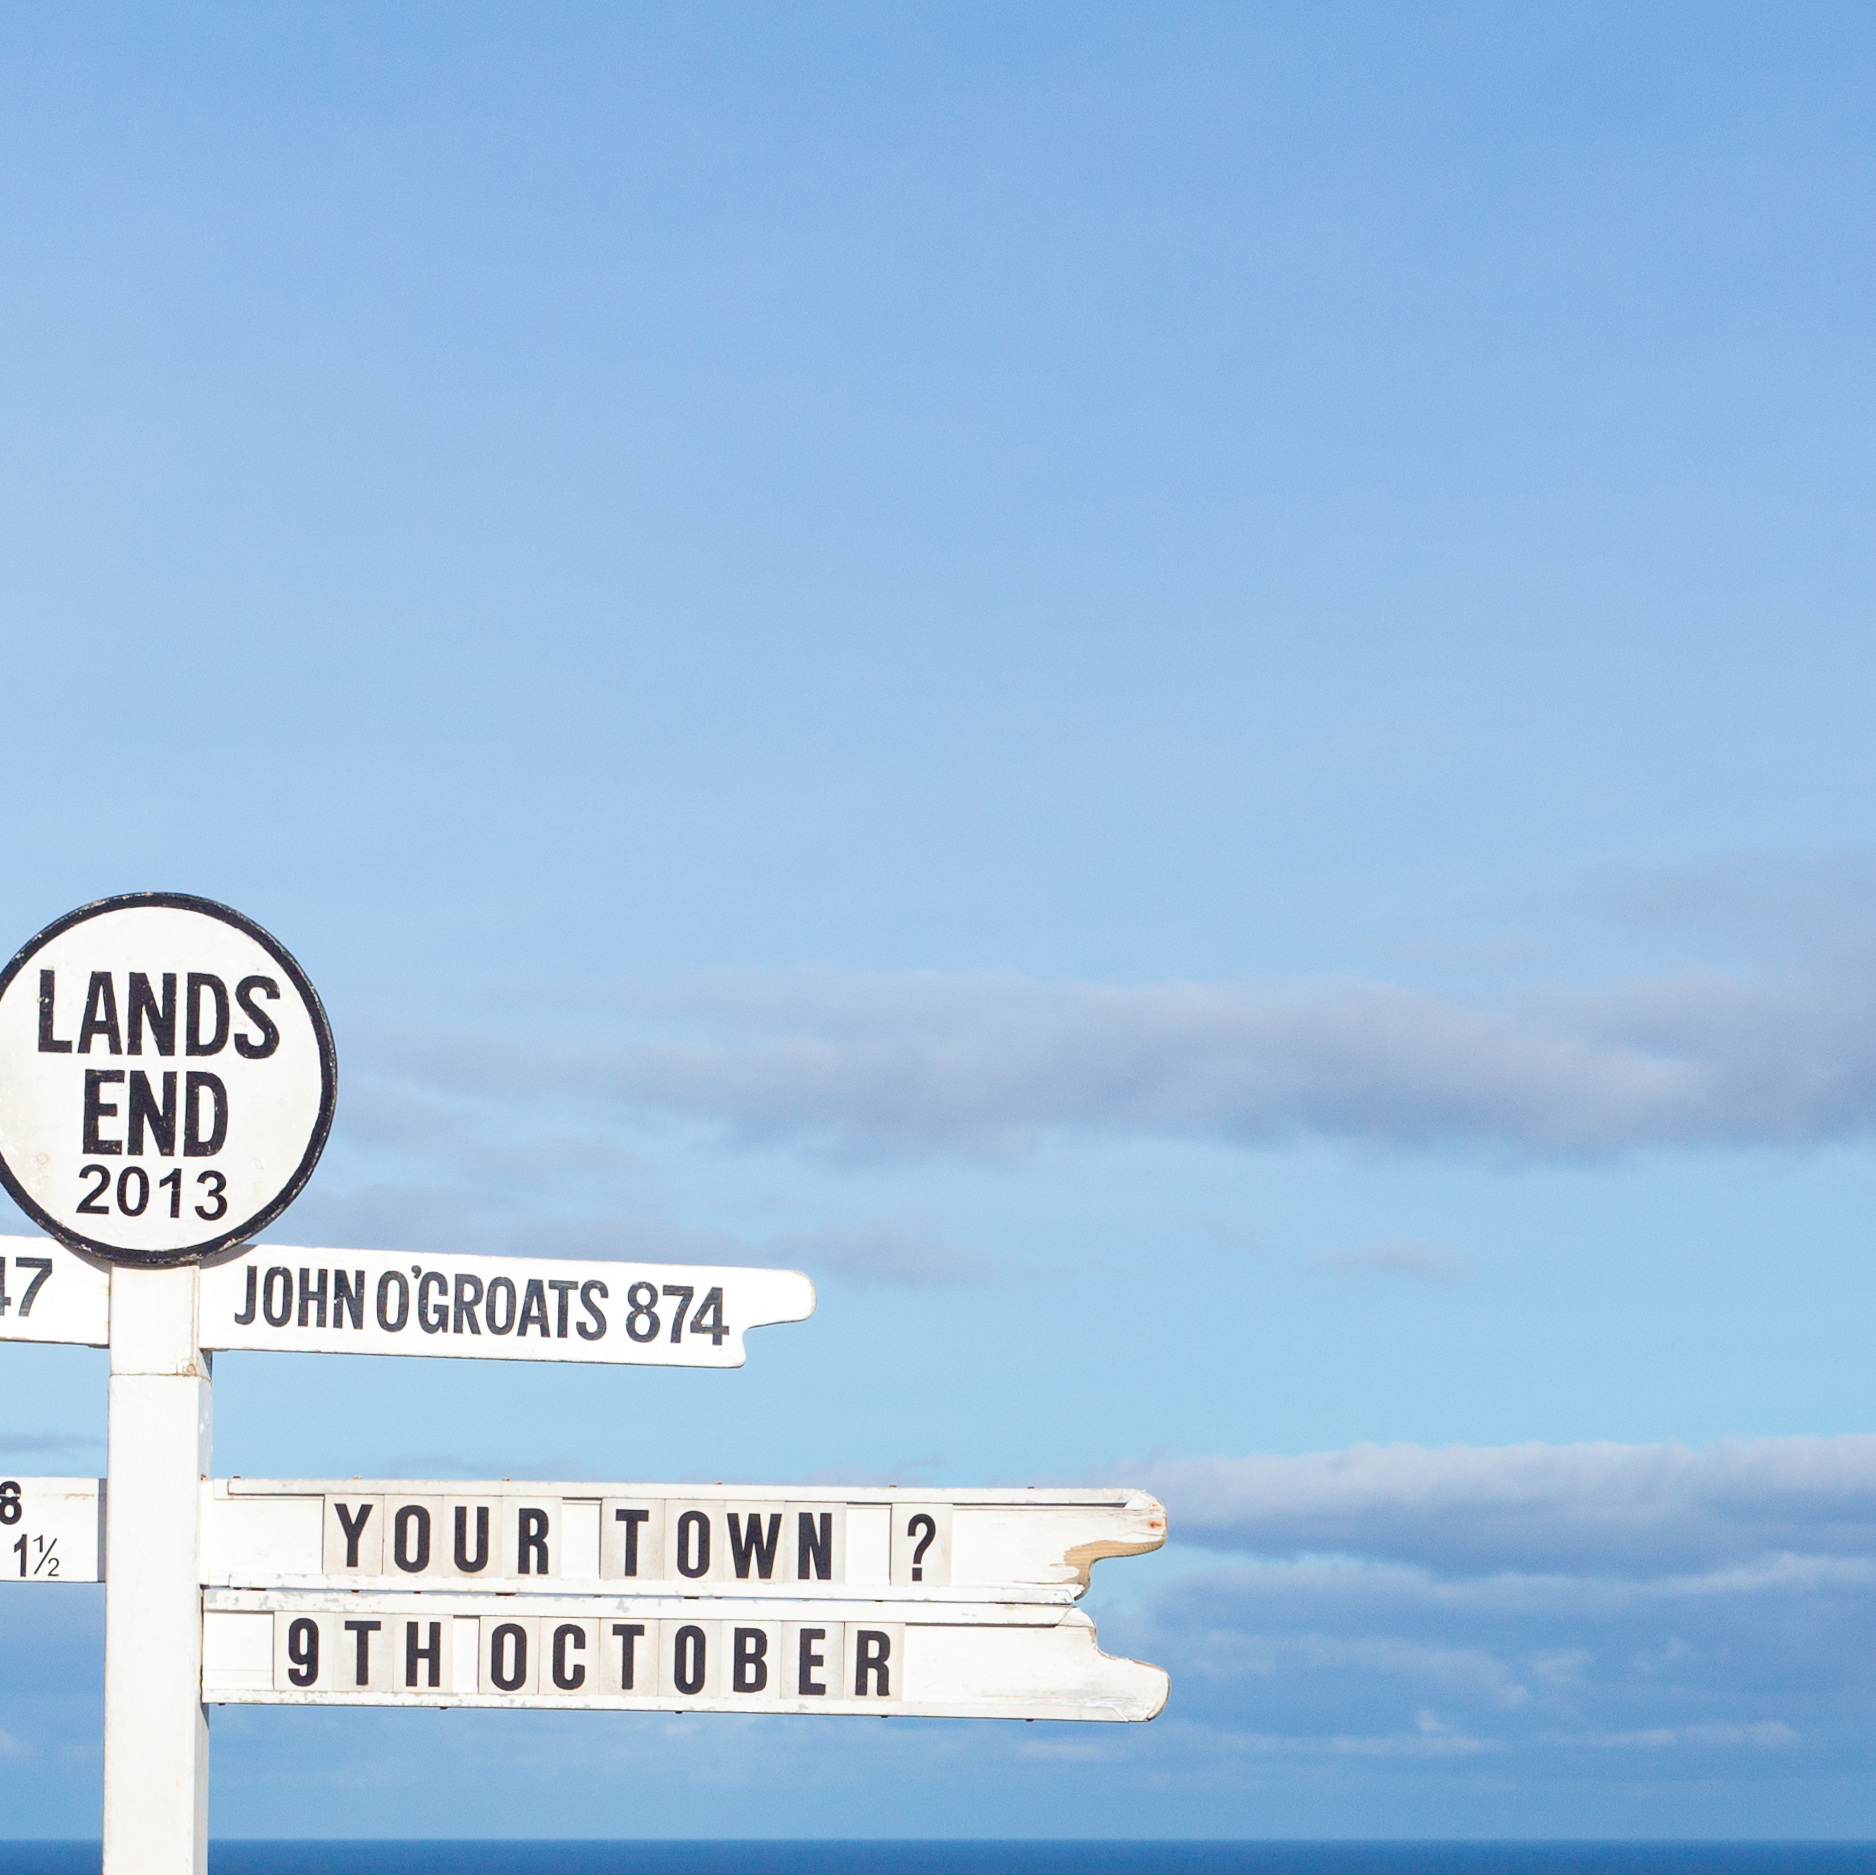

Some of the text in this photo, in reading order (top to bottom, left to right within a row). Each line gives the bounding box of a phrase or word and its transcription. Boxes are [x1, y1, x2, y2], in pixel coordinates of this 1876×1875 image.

[38, 969, 280, 1059] LANDS
[83, 1069, 228, 1157] END
[76, 1164, 227, 1221] 2013
[235, 1265, 729, 1345] JOHN O'GROATS 874
[334, 1503, 936, 1581] YOUR TOWN ?
[288, 1618, 890, 1696] 9TH OCTOBER
